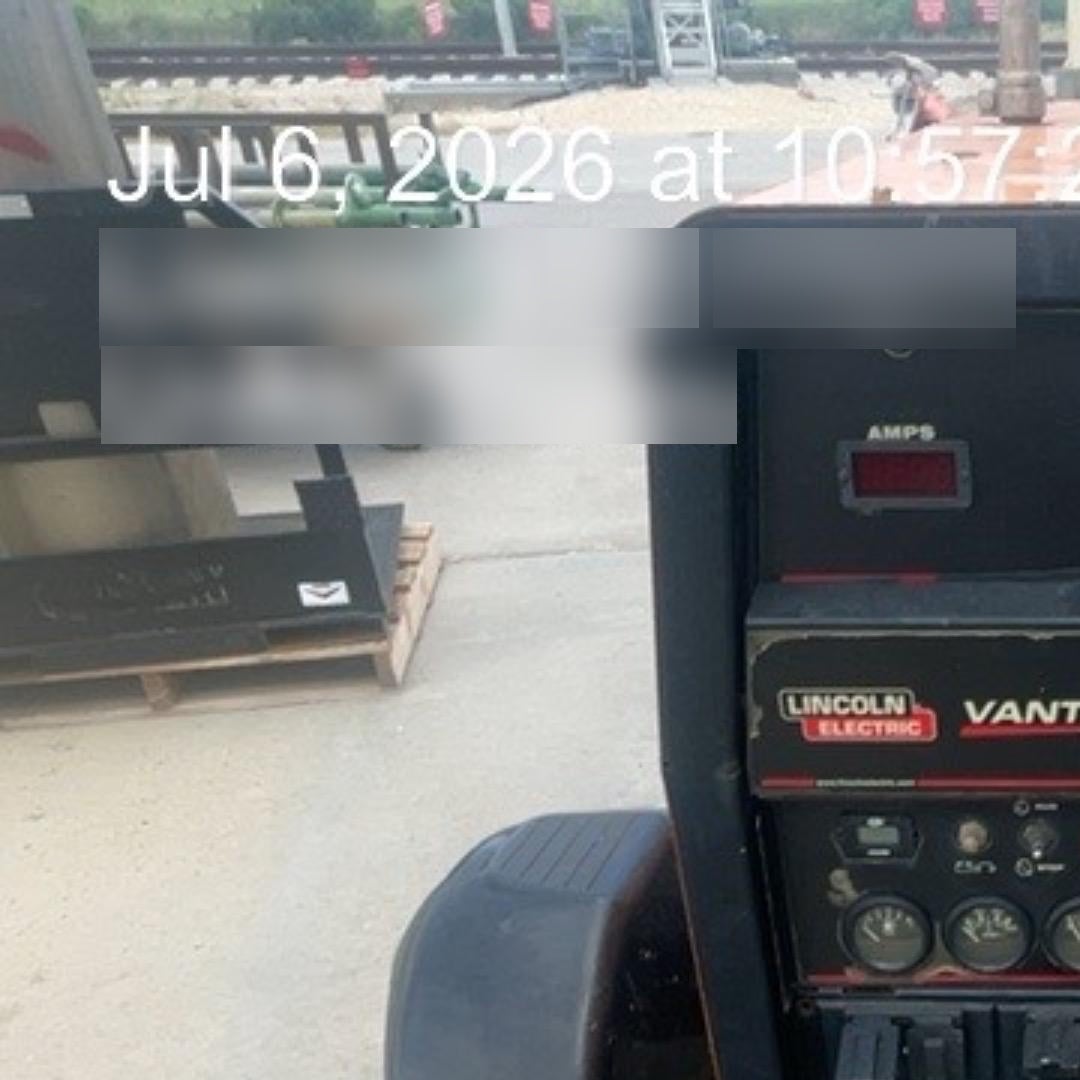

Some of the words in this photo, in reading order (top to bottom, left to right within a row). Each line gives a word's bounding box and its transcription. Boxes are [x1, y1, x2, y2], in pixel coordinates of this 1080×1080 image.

[866, 423, 937, 442] AMPS
[788, 694, 907, 716] LINCOLN
[818, 718, 923, 737] ELECTRIC
